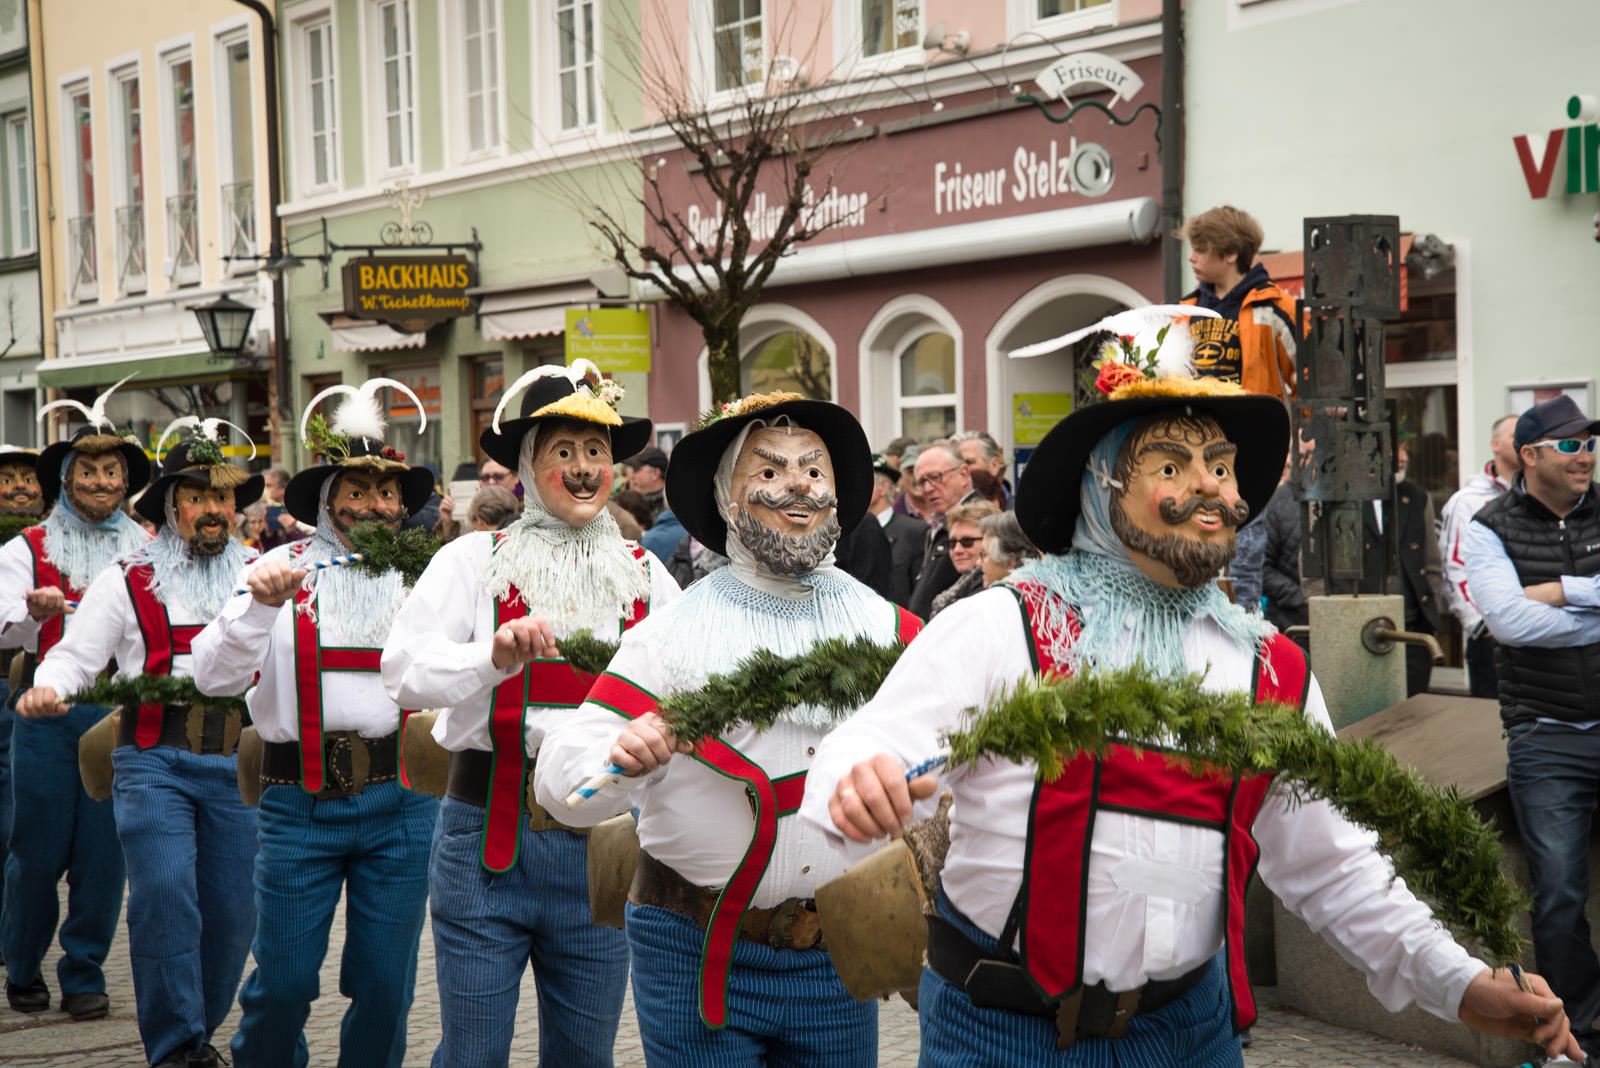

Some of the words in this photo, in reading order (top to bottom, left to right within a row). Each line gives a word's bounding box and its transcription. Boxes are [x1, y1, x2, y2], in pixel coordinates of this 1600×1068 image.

[1054, 60, 1128, 86] Friseur
[934, 161, 1006, 215] Friseur
[360, 264, 469, 290] BACKHAUS
